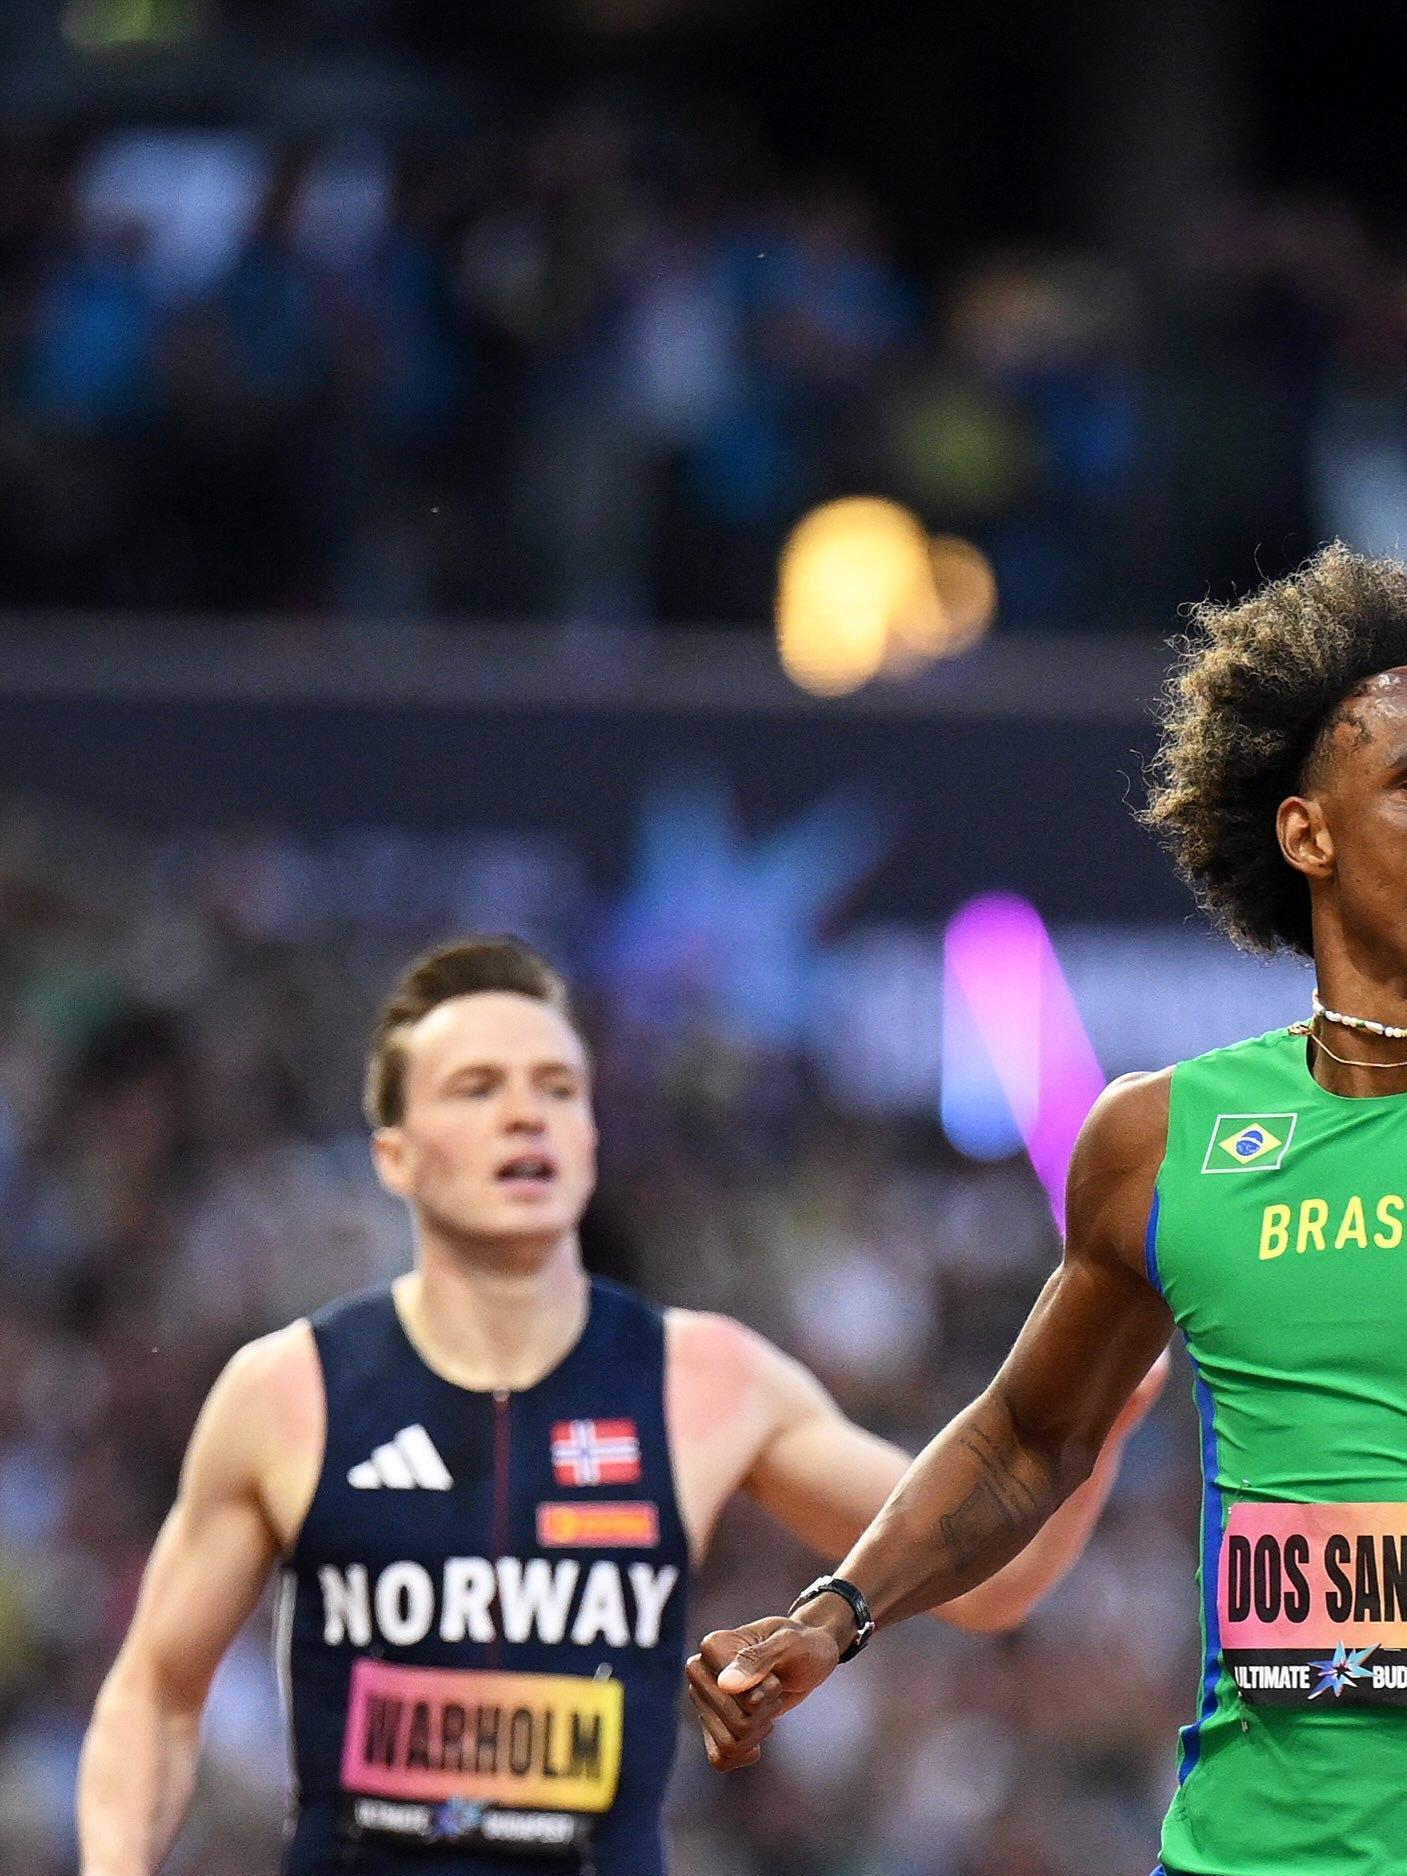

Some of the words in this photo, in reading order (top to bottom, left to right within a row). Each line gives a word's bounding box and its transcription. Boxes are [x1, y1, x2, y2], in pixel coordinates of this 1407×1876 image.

[317, 1555, 680, 1649] NORWAY
[1228, 1533, 1311, 1624] DOS
[1234, 1665, 1311, 1690] ULTIMATE
[363, 1690, 604, 1782] WARHOLM
